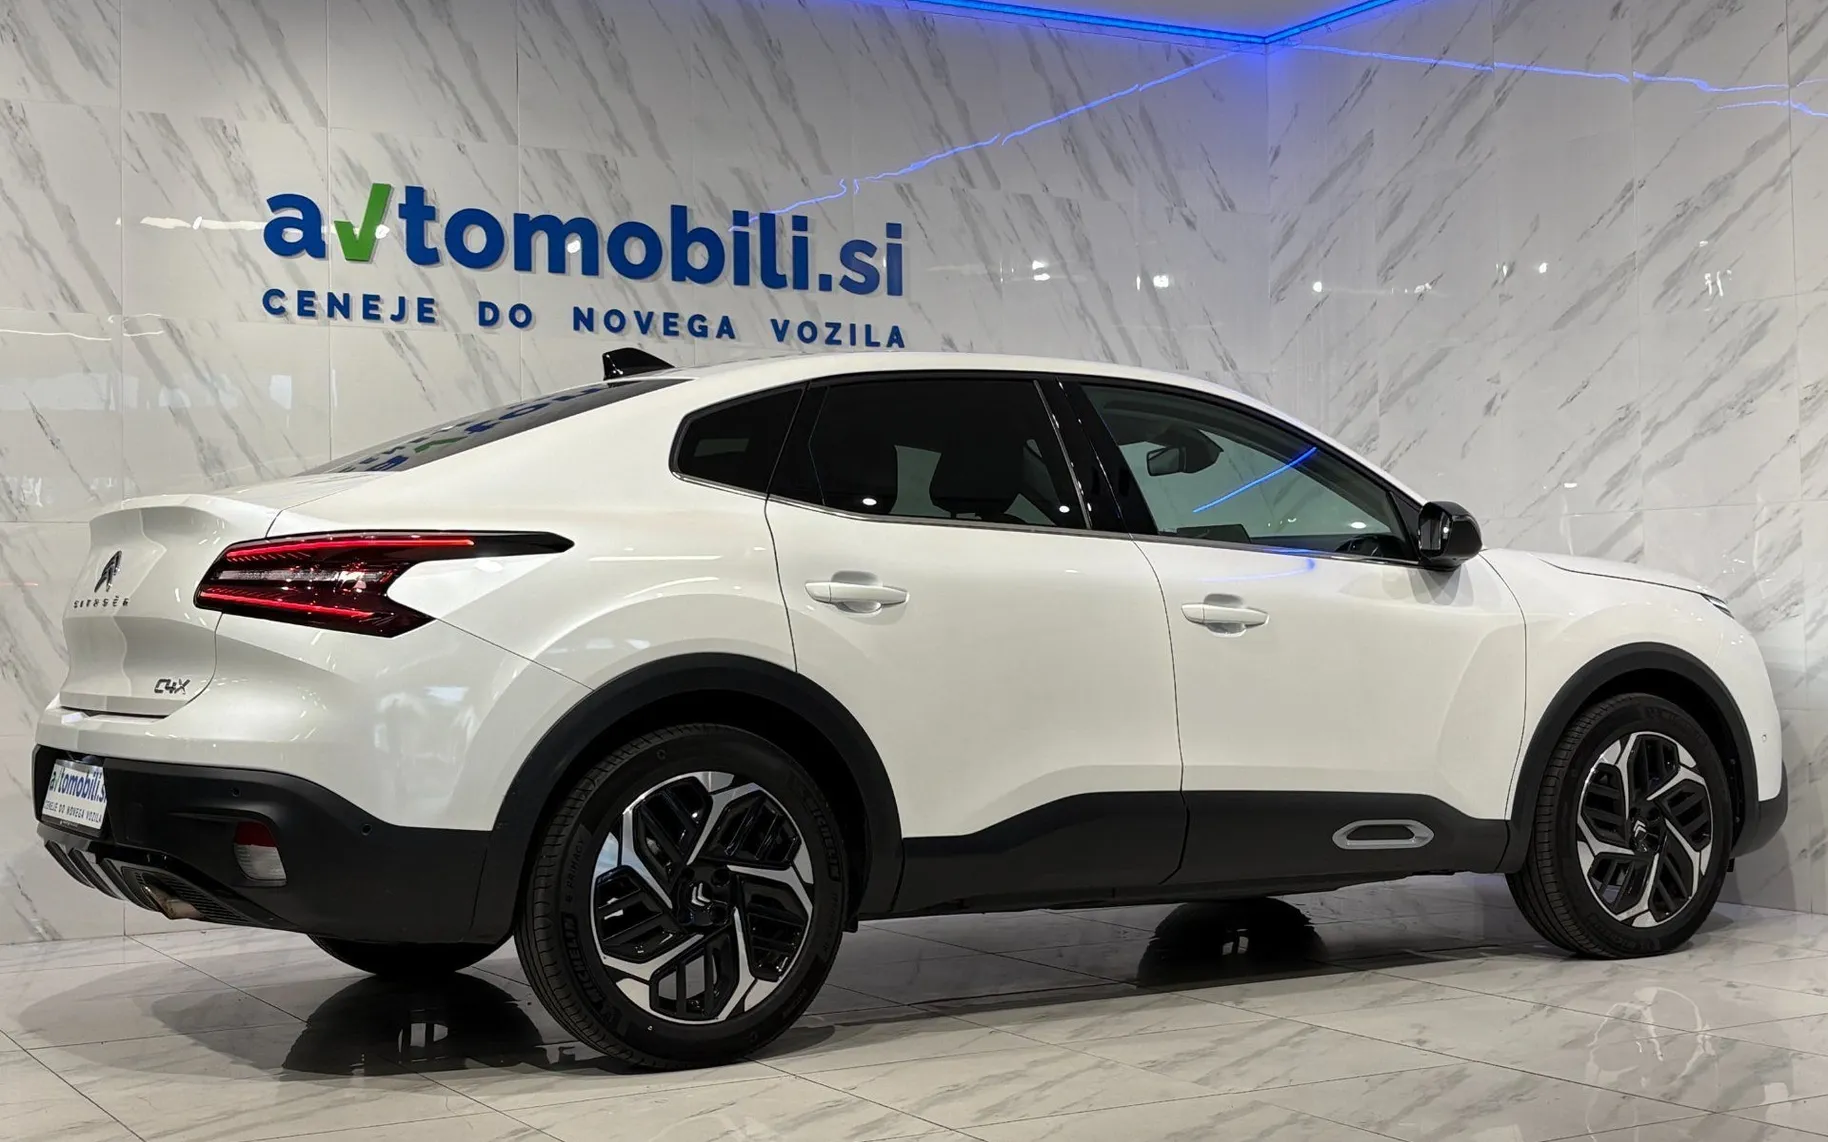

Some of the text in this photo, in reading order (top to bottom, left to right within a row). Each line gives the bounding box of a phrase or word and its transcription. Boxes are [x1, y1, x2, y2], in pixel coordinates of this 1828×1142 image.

[263, 182, 904, 297] avtomobili.si
[262, 288, 905, 349] CENEJE DO NOVEGA VOZILA
[49, 767, 106, 803] avtomobili.s
[562, 915, 605, 1004] MICHELIN
